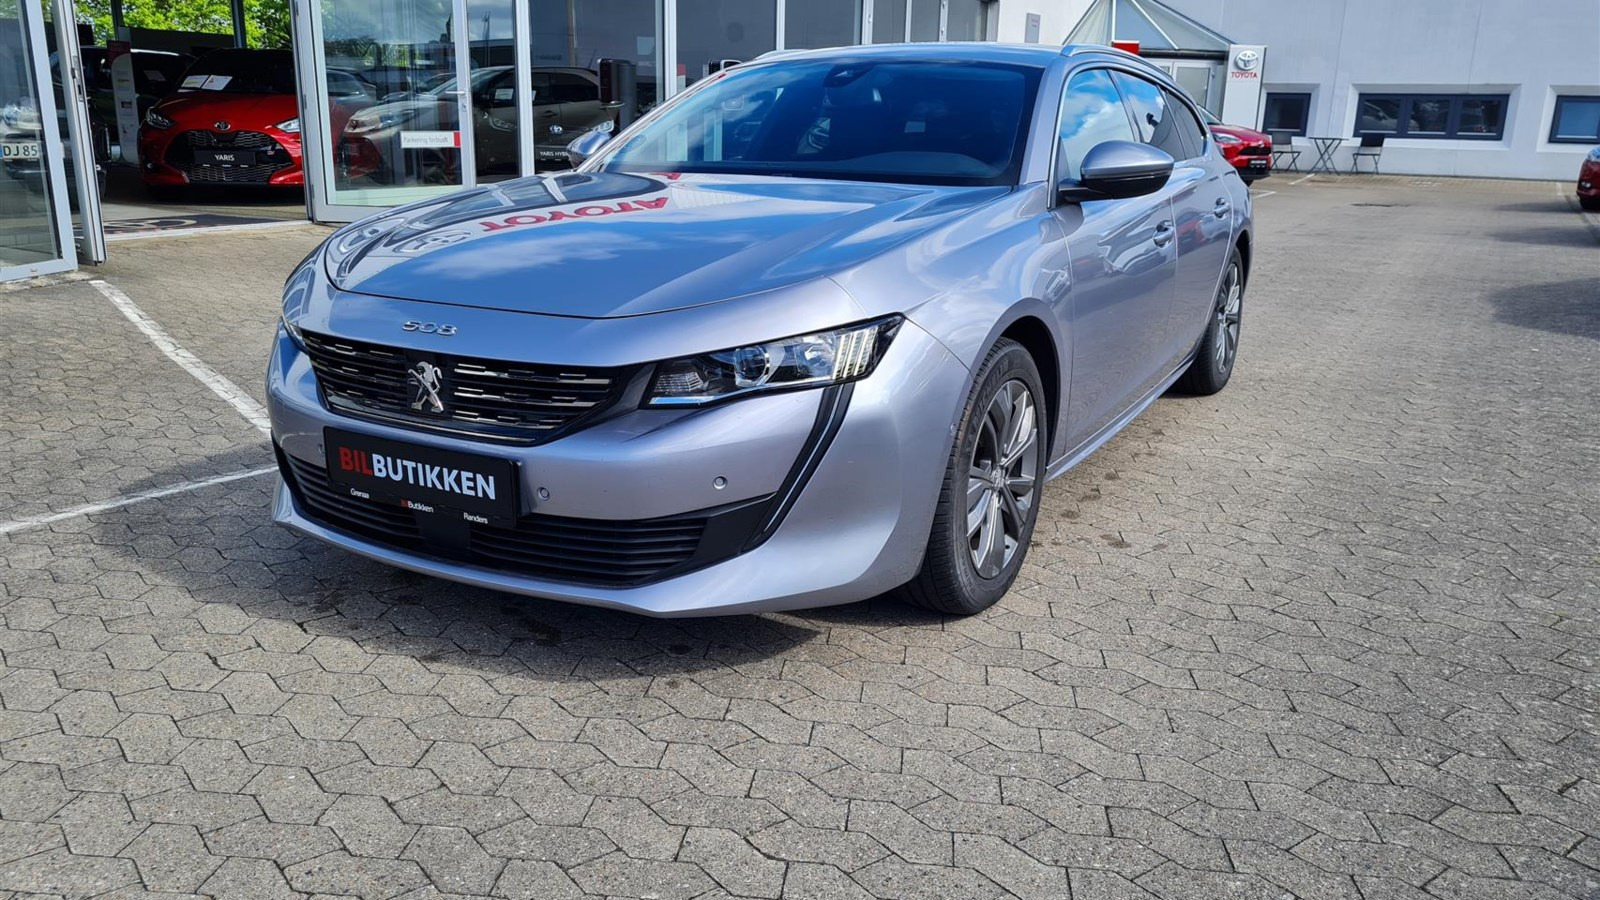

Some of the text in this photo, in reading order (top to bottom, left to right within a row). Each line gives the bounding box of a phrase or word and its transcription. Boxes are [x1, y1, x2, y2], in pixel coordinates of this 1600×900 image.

[1231, 71, 1258, 79] TOYOTA
[3, 145, 38, 157] DJ 85
[214, 154, 235, 162] YARIS
[402, 320, 457, 336] 508
[339, 446, 496, 500] BILBUTIKKEN
[463, 511, 488, 524] Randers
